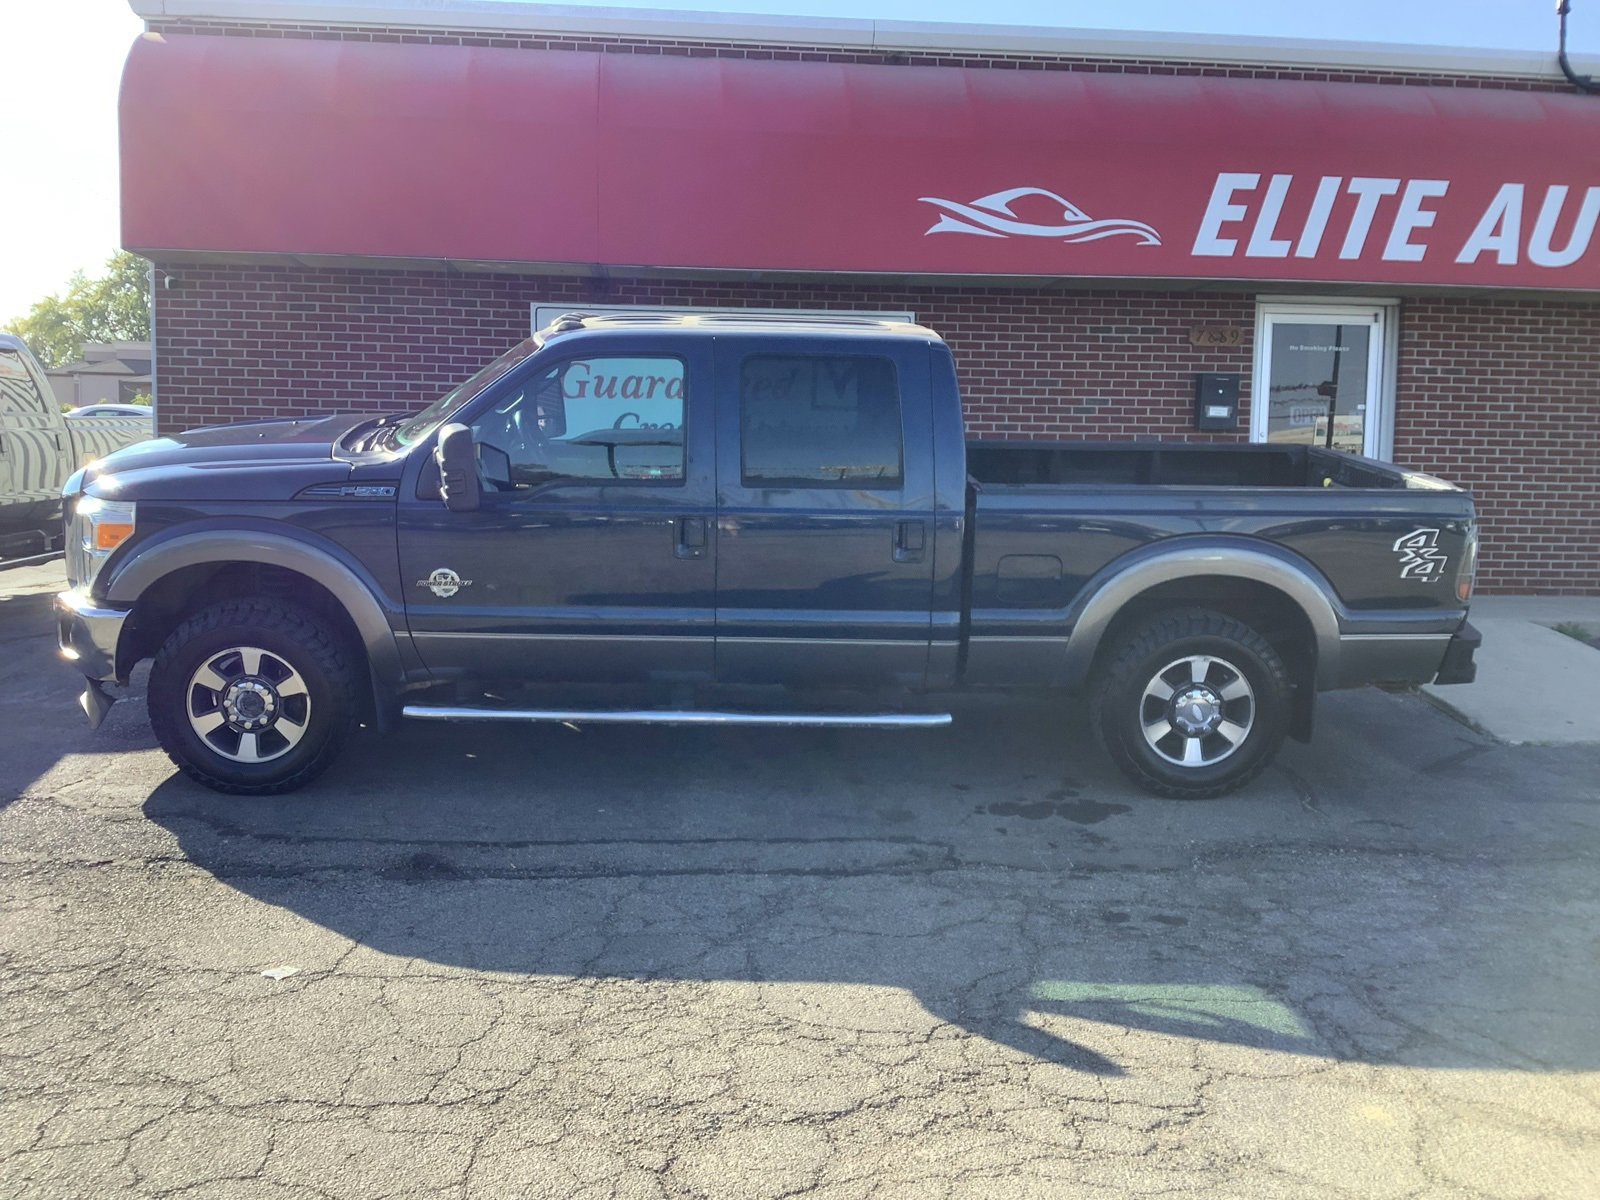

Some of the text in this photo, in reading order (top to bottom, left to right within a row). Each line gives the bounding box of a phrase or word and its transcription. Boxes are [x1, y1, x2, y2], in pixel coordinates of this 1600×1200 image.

[1191, 172, 1600, 268] ELITE AU
[1299, 344, 1327, 352] Smoking
